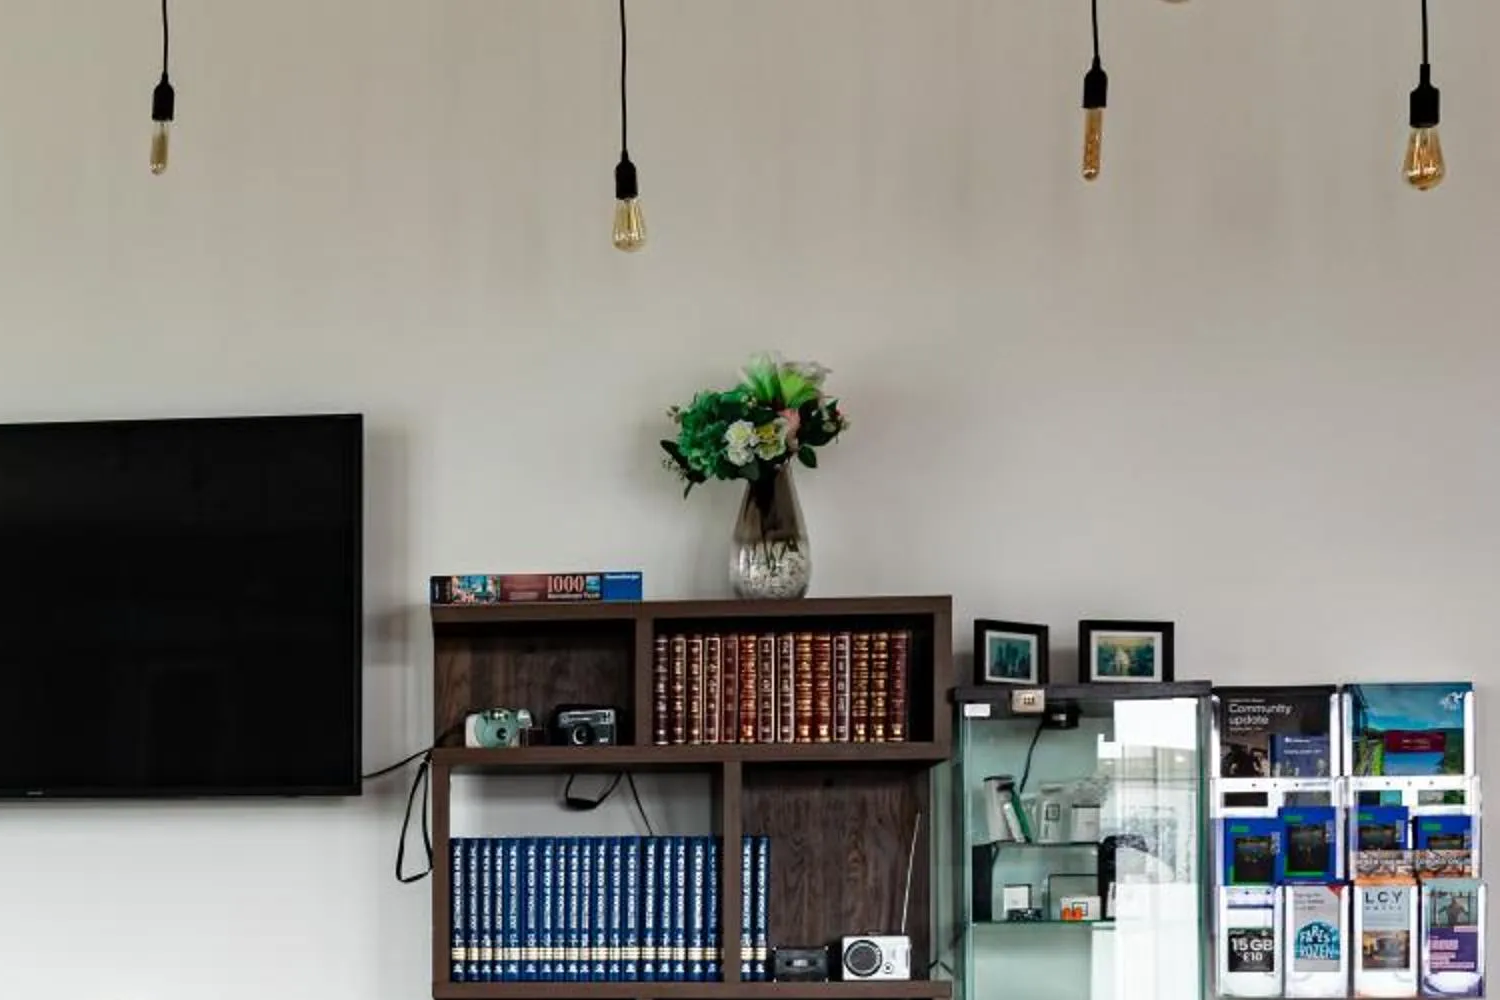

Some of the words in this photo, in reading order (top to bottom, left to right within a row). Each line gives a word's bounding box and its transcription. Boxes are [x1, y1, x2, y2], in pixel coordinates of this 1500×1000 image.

[548, 575, 585, 593] 1000
[1228, 703, 1292, 715] Community
[1228, 715, 1269, 726] update
[1365, 891, 1403, 904] LCY
